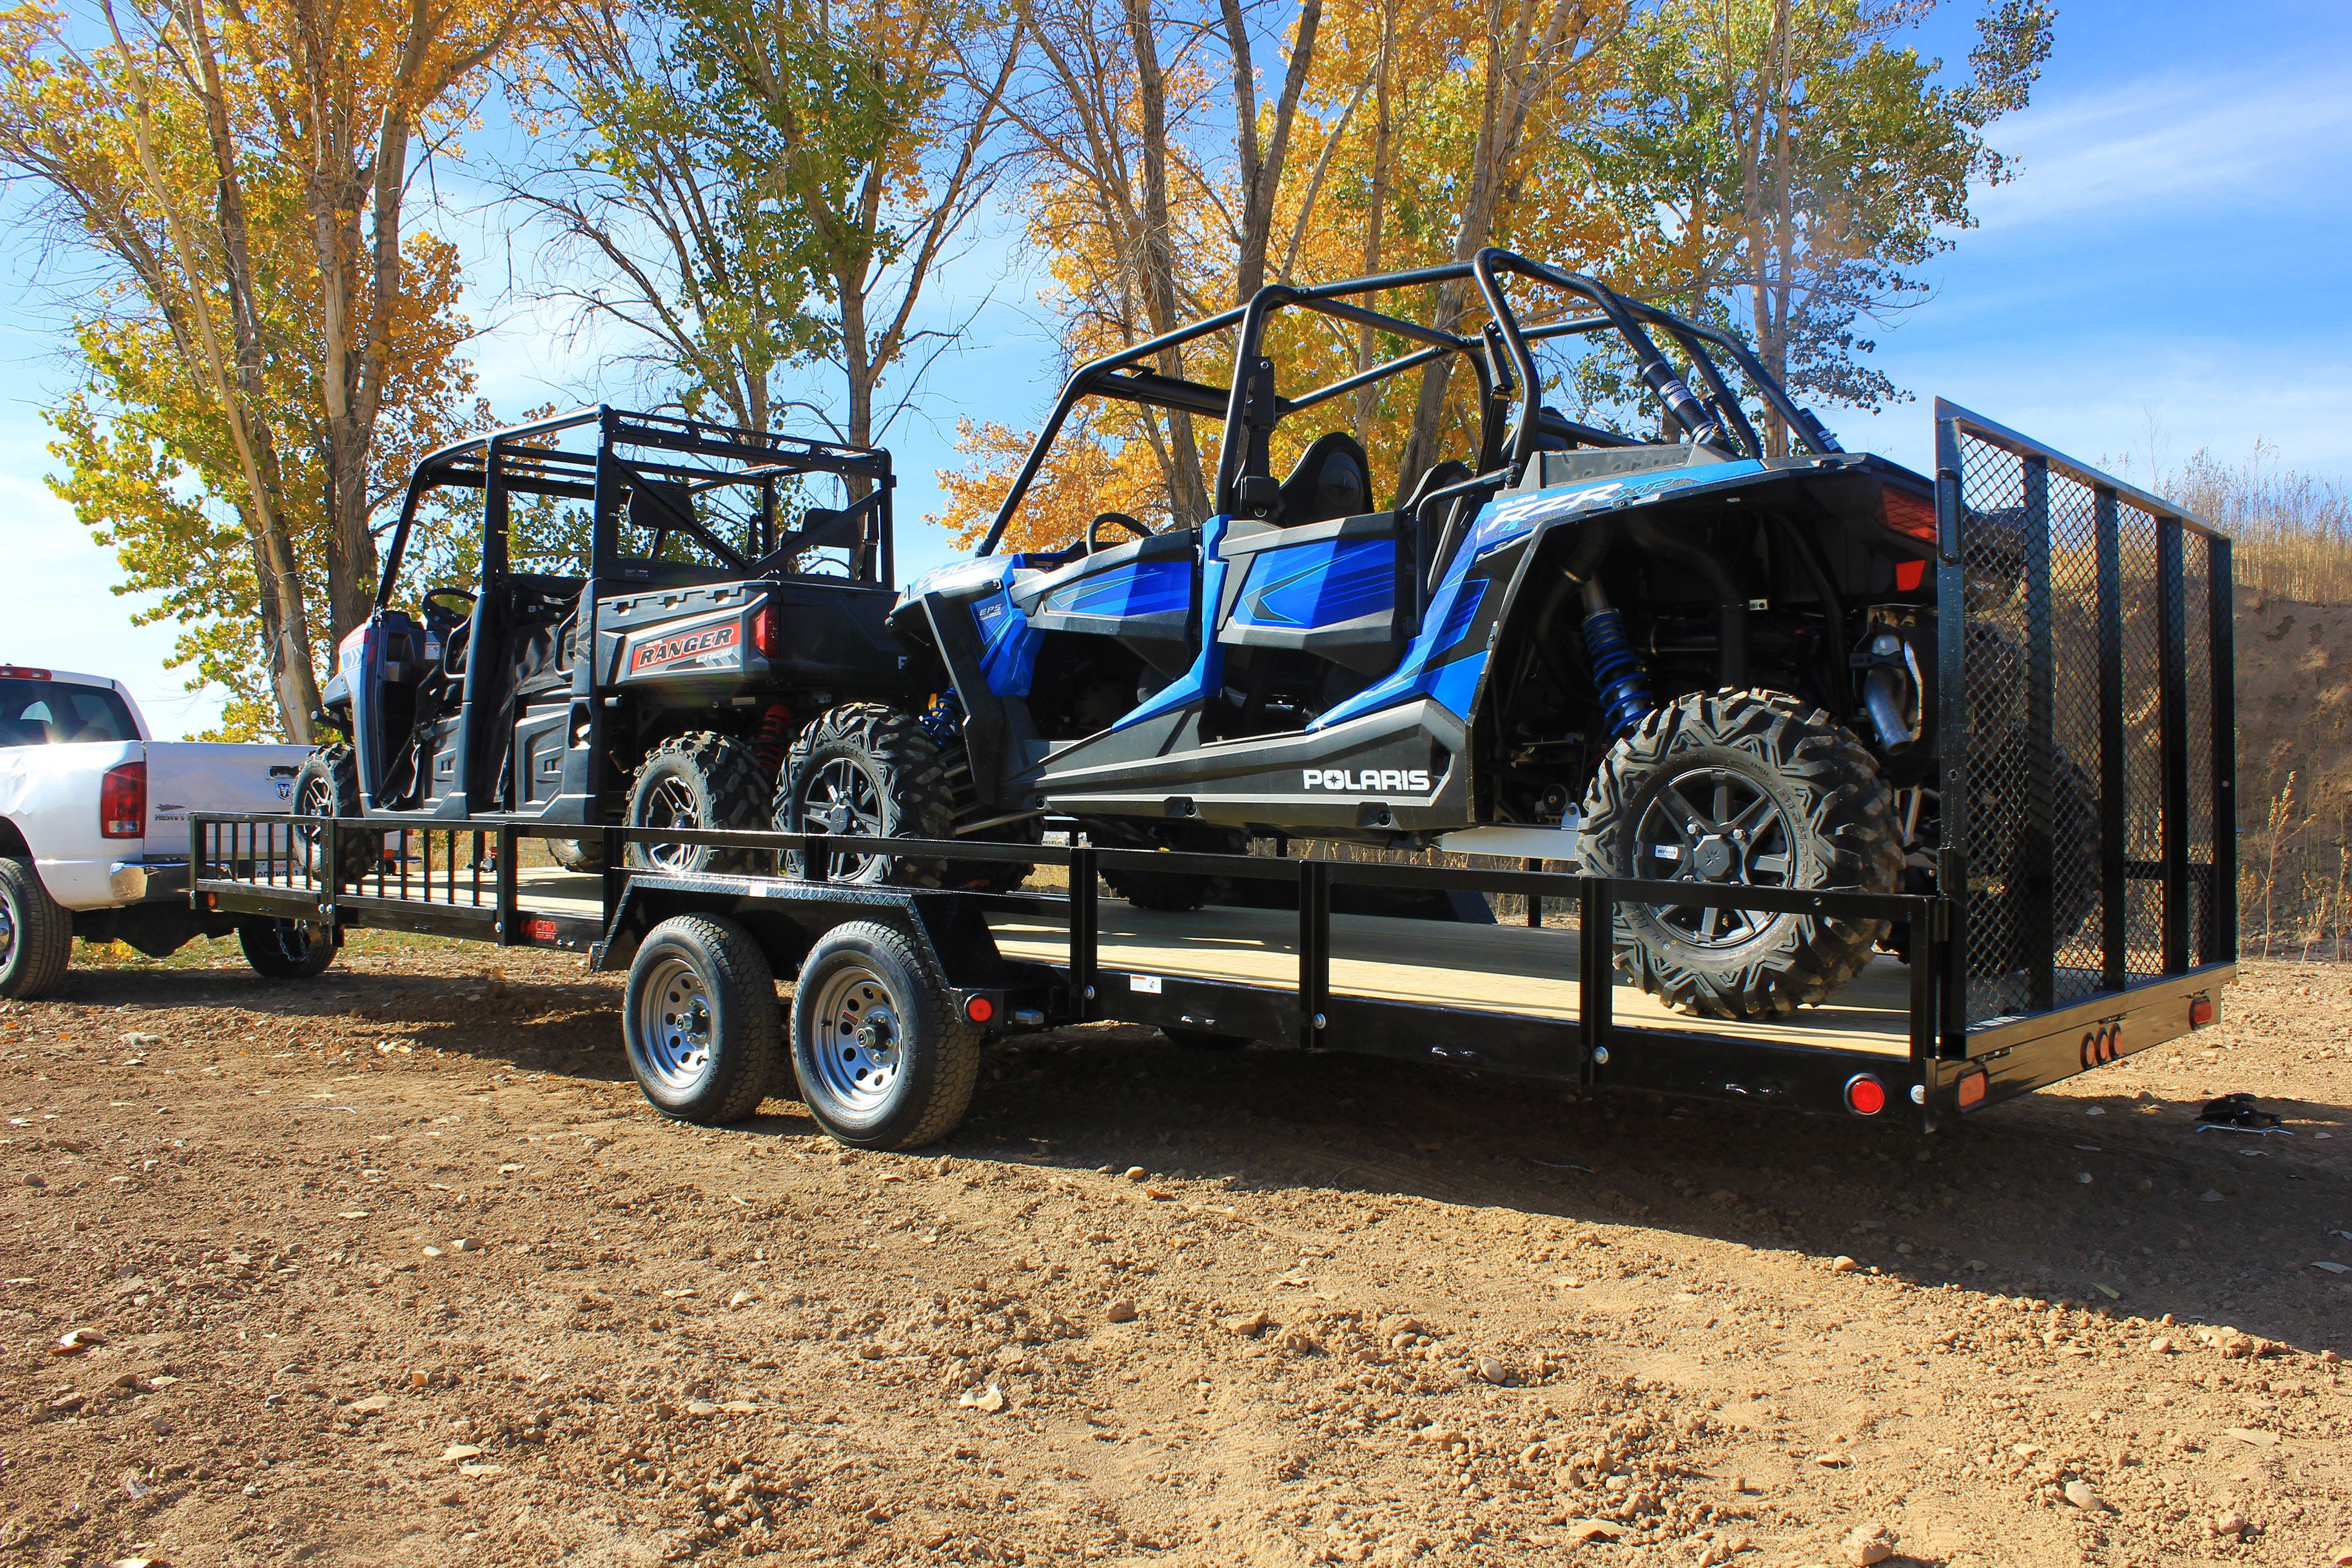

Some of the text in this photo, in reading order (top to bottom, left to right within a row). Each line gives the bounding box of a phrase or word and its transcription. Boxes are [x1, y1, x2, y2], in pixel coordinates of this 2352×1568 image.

[1483, 477, 1675, 535] RZR XP
[1496, 494, 1538, 511] POLARIS
[1499, 520, 1519, 533] 4
[979, 603, 1002, 616] EPS
[638, 627, 734, 667] RANGER
[645, 639, 663, 647] POLARIS
[696, 647, 734, 664] CREW
[1302, 769, 1430, 791] POLARIS
[531, 920, 557, 932] ECHO
